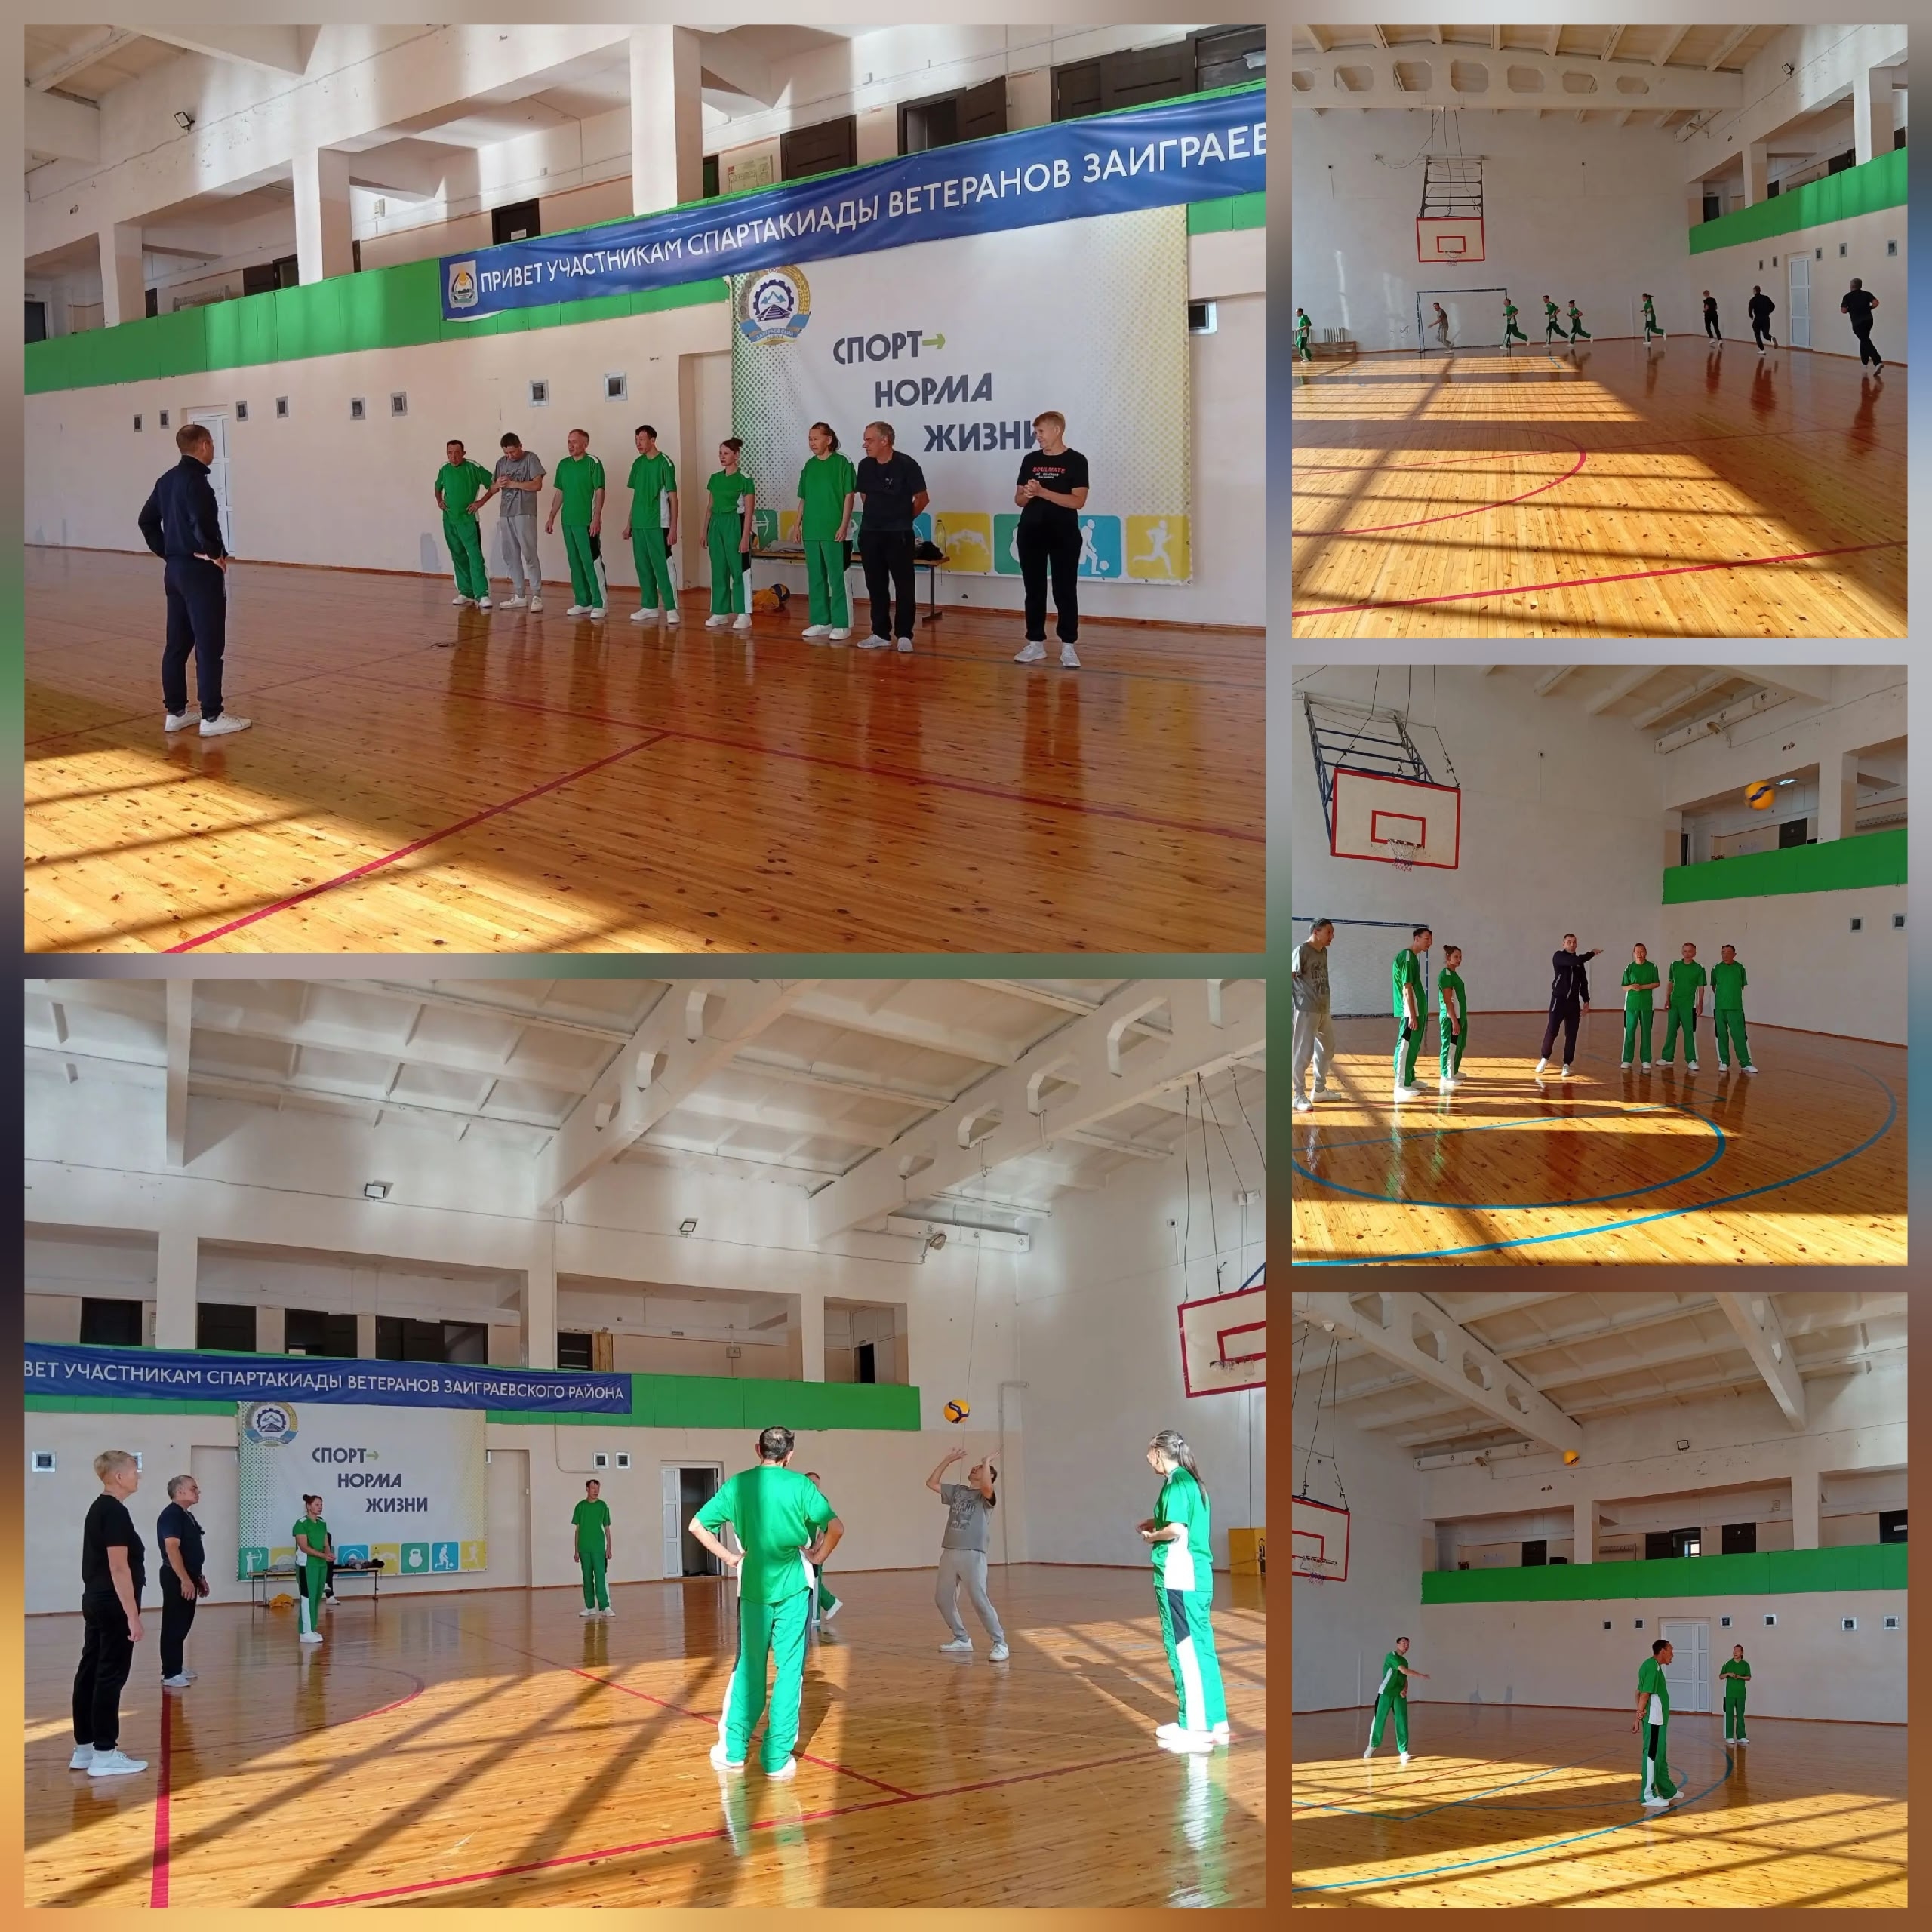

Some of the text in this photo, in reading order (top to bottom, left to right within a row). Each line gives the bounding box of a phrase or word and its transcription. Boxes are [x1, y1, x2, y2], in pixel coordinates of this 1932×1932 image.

[480, 262, 543, 293] ПРИВЕТ
[547, 238, 682, 281] УЧАСТНИКАМ
[688, 195, 879, 257] СПАРТАКИАДЫ
[889, 159, 1072, 217] ВЕТЕРАНОВ
[833, 330, 923, 365] СПОРТ
[875, 372, 992, 408] НОРМА
[24, 1361, 625, 1399] ВЕТ УЧАСТНИКАМ СПАРТАКИАДЫ ВЕТЕРАНОВ ЗАИГРАЕВСКОГО РАЙОНА
[312, 1447, 367, 1463] СПОРТ
[337, 1473, 402, 1488] НОРМА
[365, 1497, 428, 1512] ЖИЗНИ
